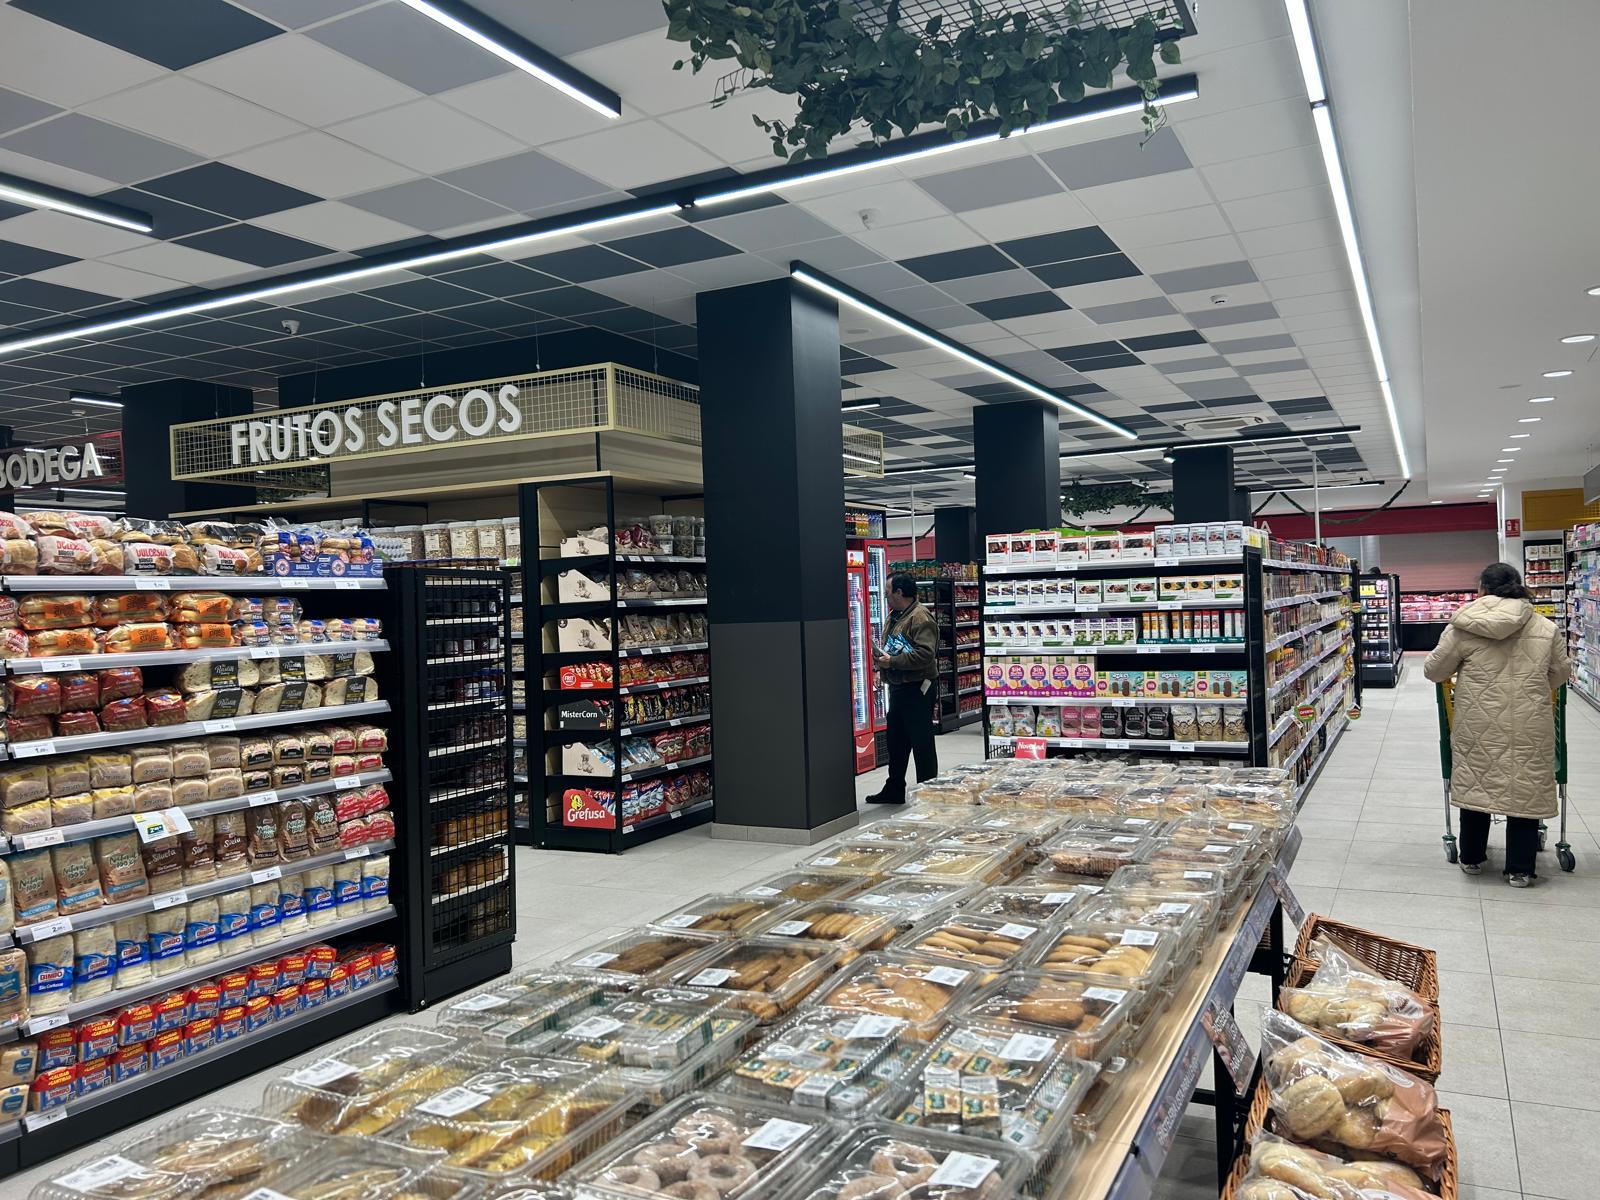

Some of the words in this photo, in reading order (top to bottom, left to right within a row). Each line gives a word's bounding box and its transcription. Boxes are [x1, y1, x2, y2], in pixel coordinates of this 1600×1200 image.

[230, 406, 366, 465] FRUTOS
[376, 384, 523, 448] SECOS
[567, 808, 606, 822] Grefusa
[40, 971, 63, 980] BIMBO
